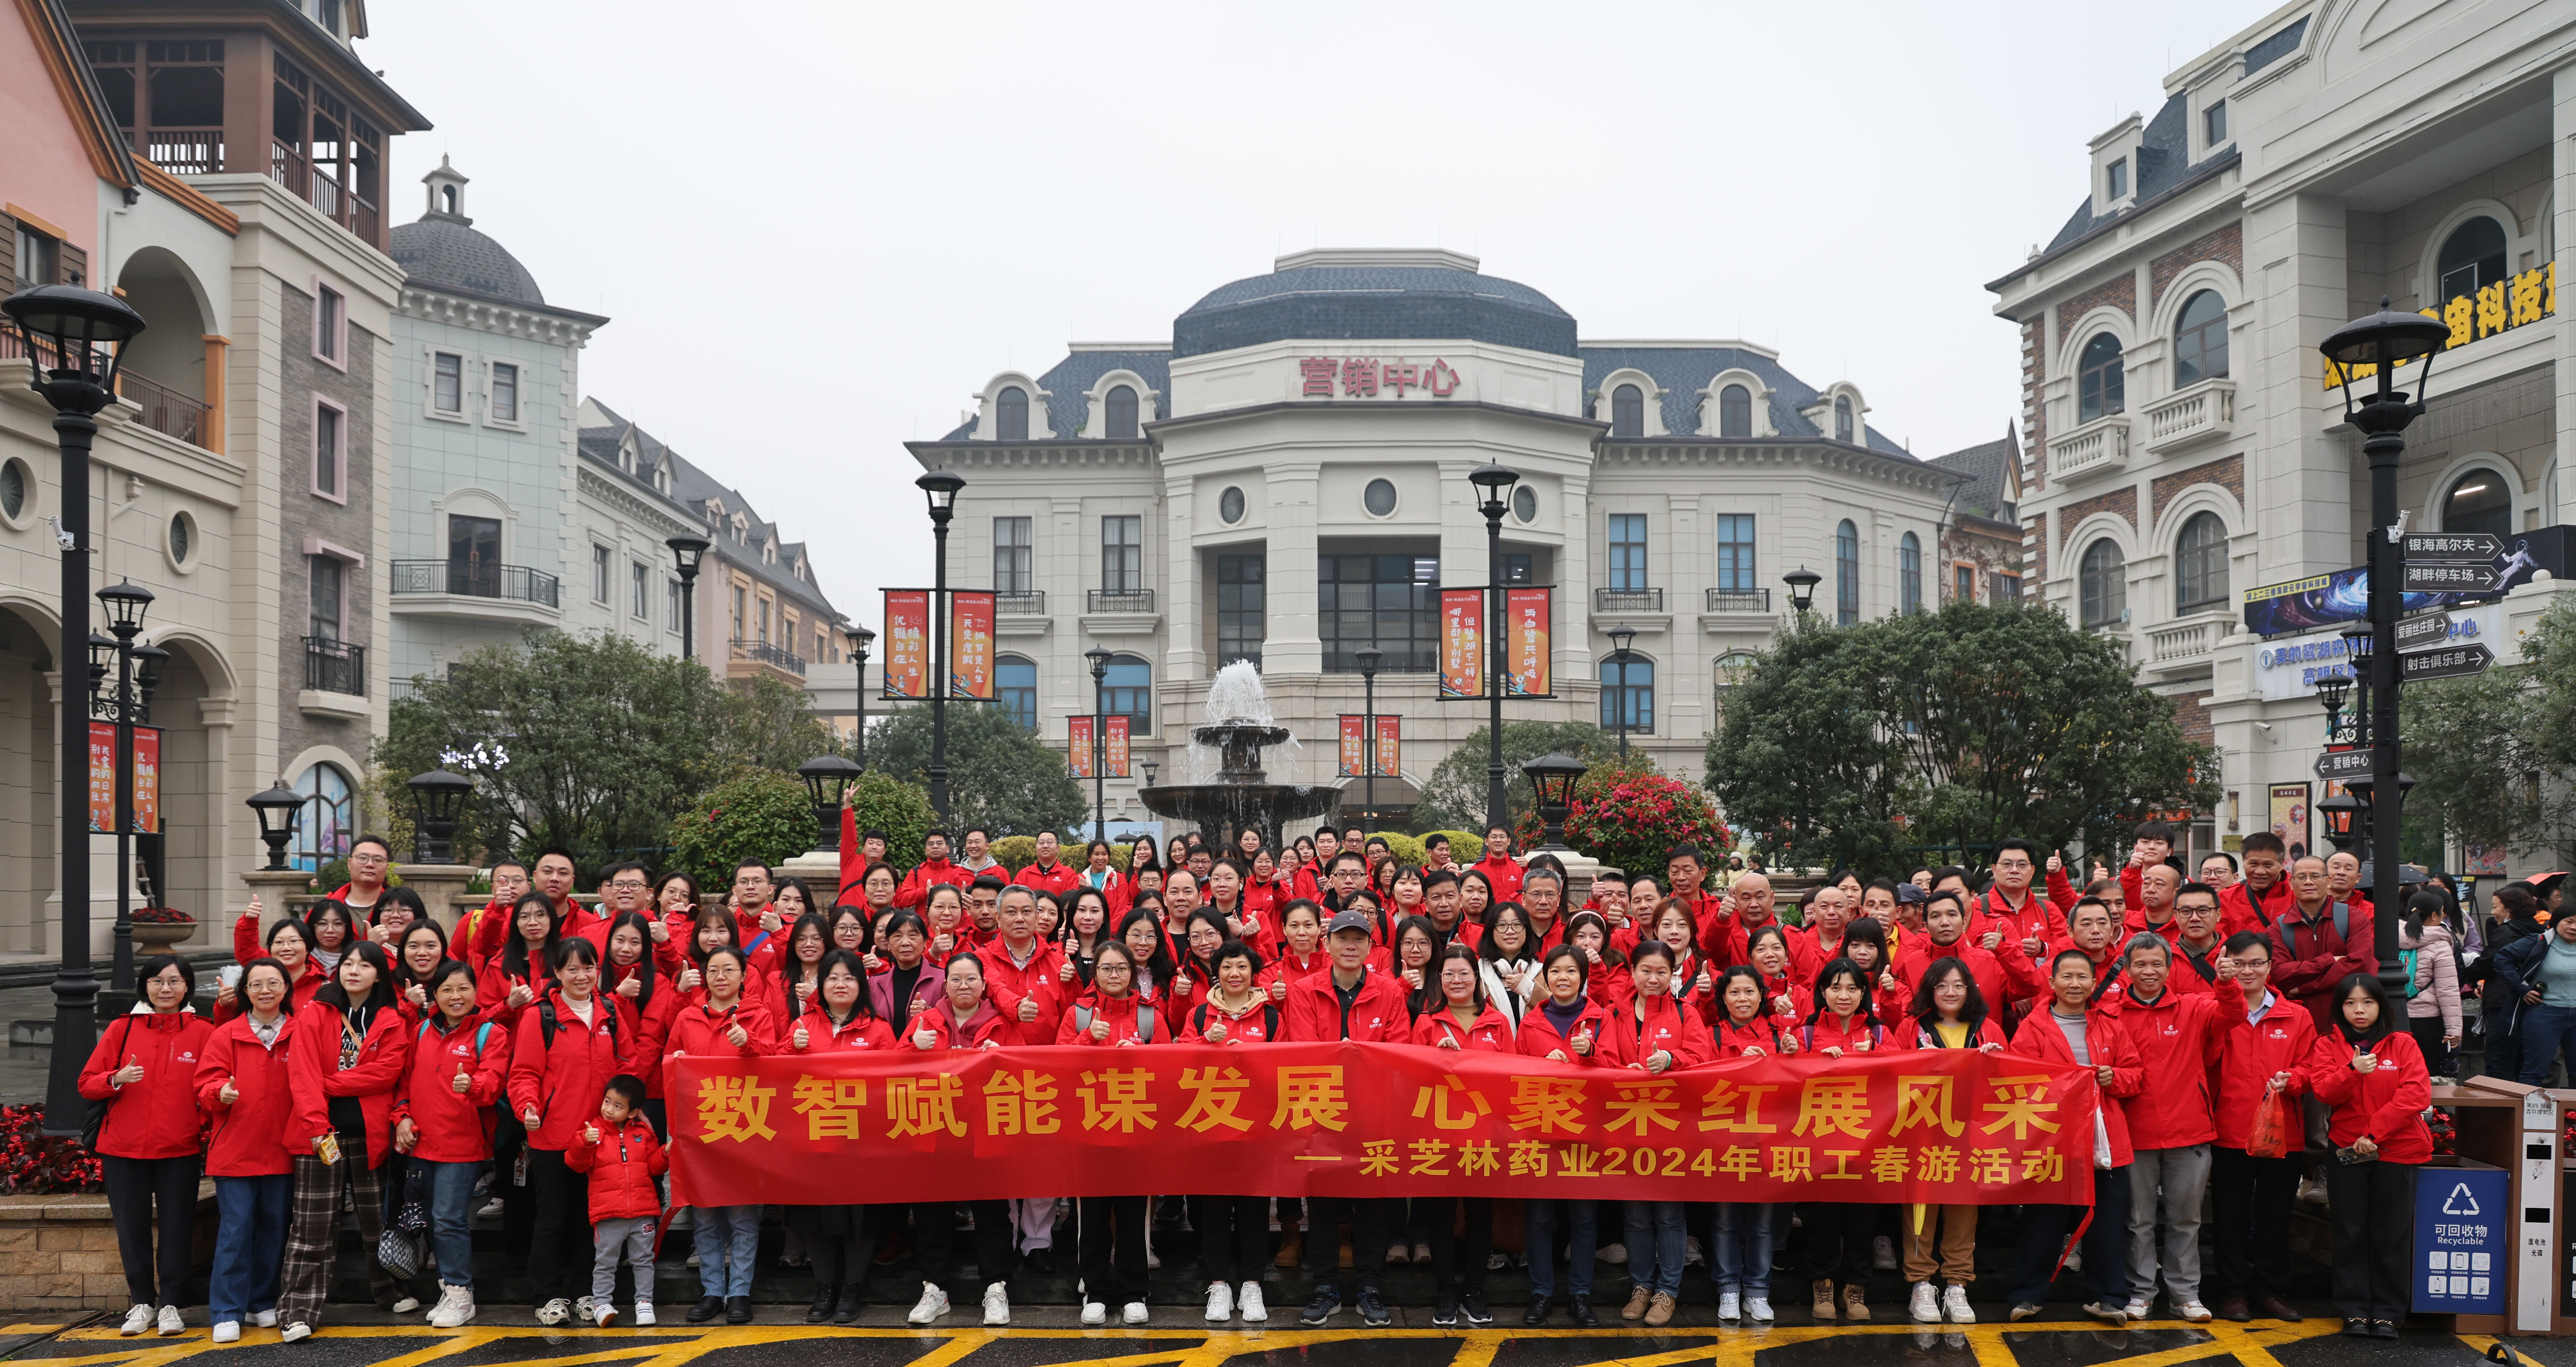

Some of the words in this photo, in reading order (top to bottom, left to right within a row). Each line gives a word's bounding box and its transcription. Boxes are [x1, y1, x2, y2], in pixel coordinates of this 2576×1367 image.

[1300, 357, 1461, 396] 营销中心
[2409, 538, 2475, 551] 银海高尔夫
[2409, 568, 2474, 582] 湖畔停车场
[893, 615, 907, 663] 优雅自在
[908, 627, 920, 676] 精彩人生
[962, 614, 973, 664] 一天是度假
[1449, 608, 1461, 668] 哪里都有别墅
[1464, 617, 1476, 677] 但鹭湖不一样
[1524, 608, 1537, 678] 与白鹭共呼吸
[2397, 619, 2435, 639] 爱丽丝庄园
[2407, 652, 2466, 671] 射击俱乐部
[91, 744, 100, 802] 别人的向往
[101, 745, 110, 803] 我家的日常
[136, 751, 146, 800] 优雅自在
[2333, 754, 2369, 769] 营销中心
[146, 764, 155, 812] 精彩人生
[697, 1065, 1349, 1144] 数智赋能谋发展
[1412, 1074, 2061, 1140] 心聚采红展风采
[2434, 1224, 2488, 1237] 可回收物
[2438, 1237, 2484, 1246] Recyclable
